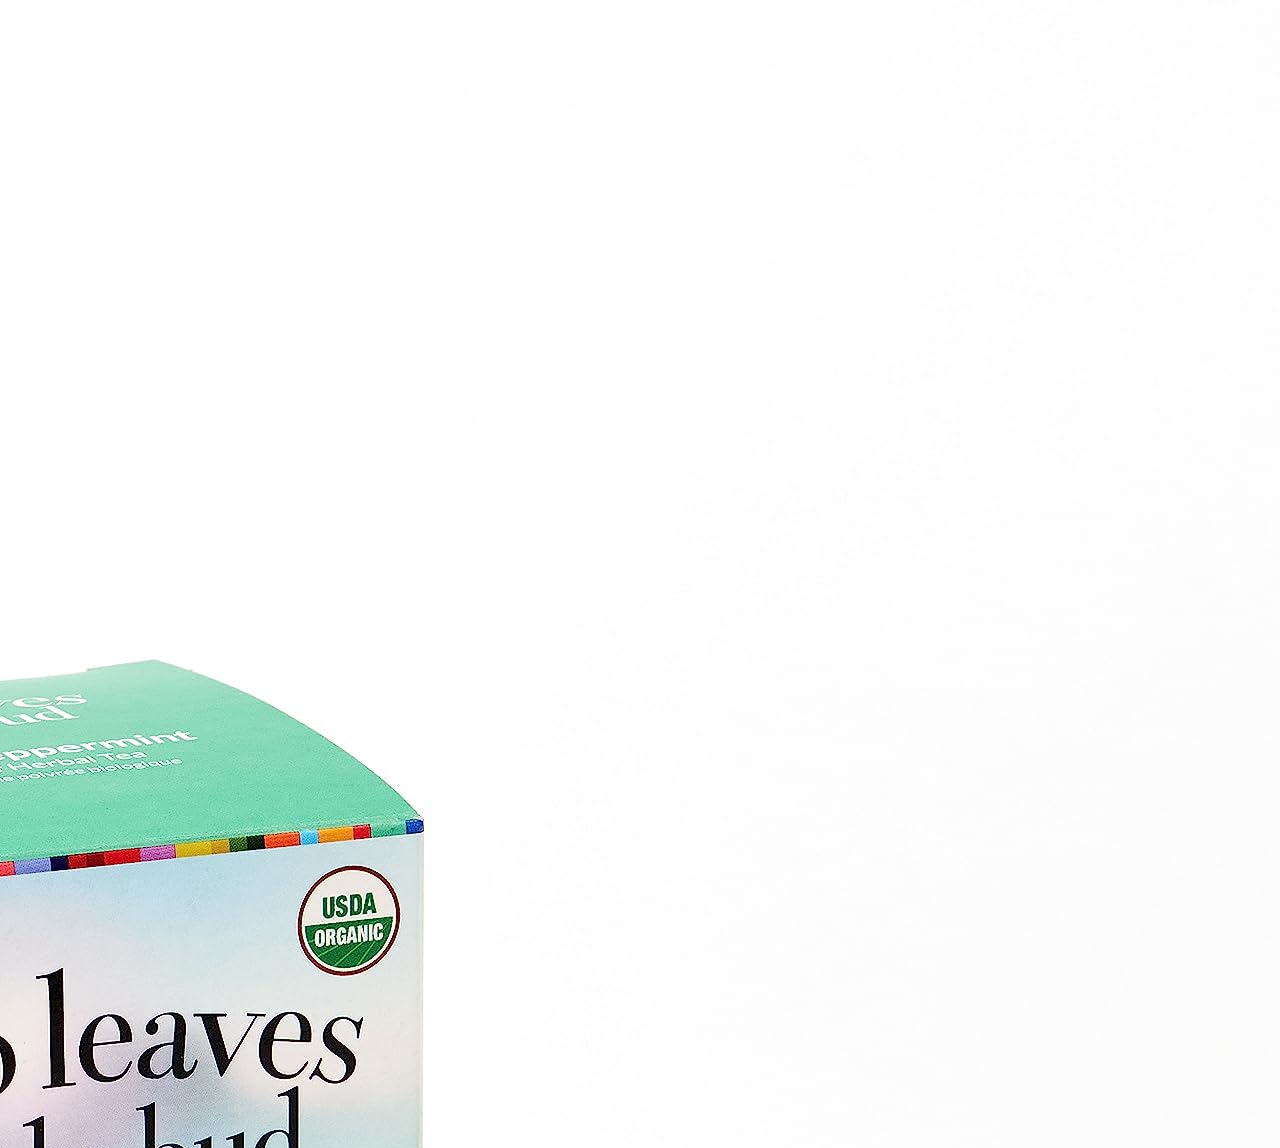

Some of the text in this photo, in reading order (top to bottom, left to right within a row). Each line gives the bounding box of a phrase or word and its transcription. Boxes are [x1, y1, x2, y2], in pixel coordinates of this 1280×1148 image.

[7, 755, 98, 772] Herbal
[96, 751, 148, 762] Tea
[16, 769, 87, 783] poivrée
[87, 758, 183, 775] biologique
[322, 892, 377, 919] USDA
[314, 923, 384, 947] ORGANIC
[35, 967, 364, 1090] leaves
